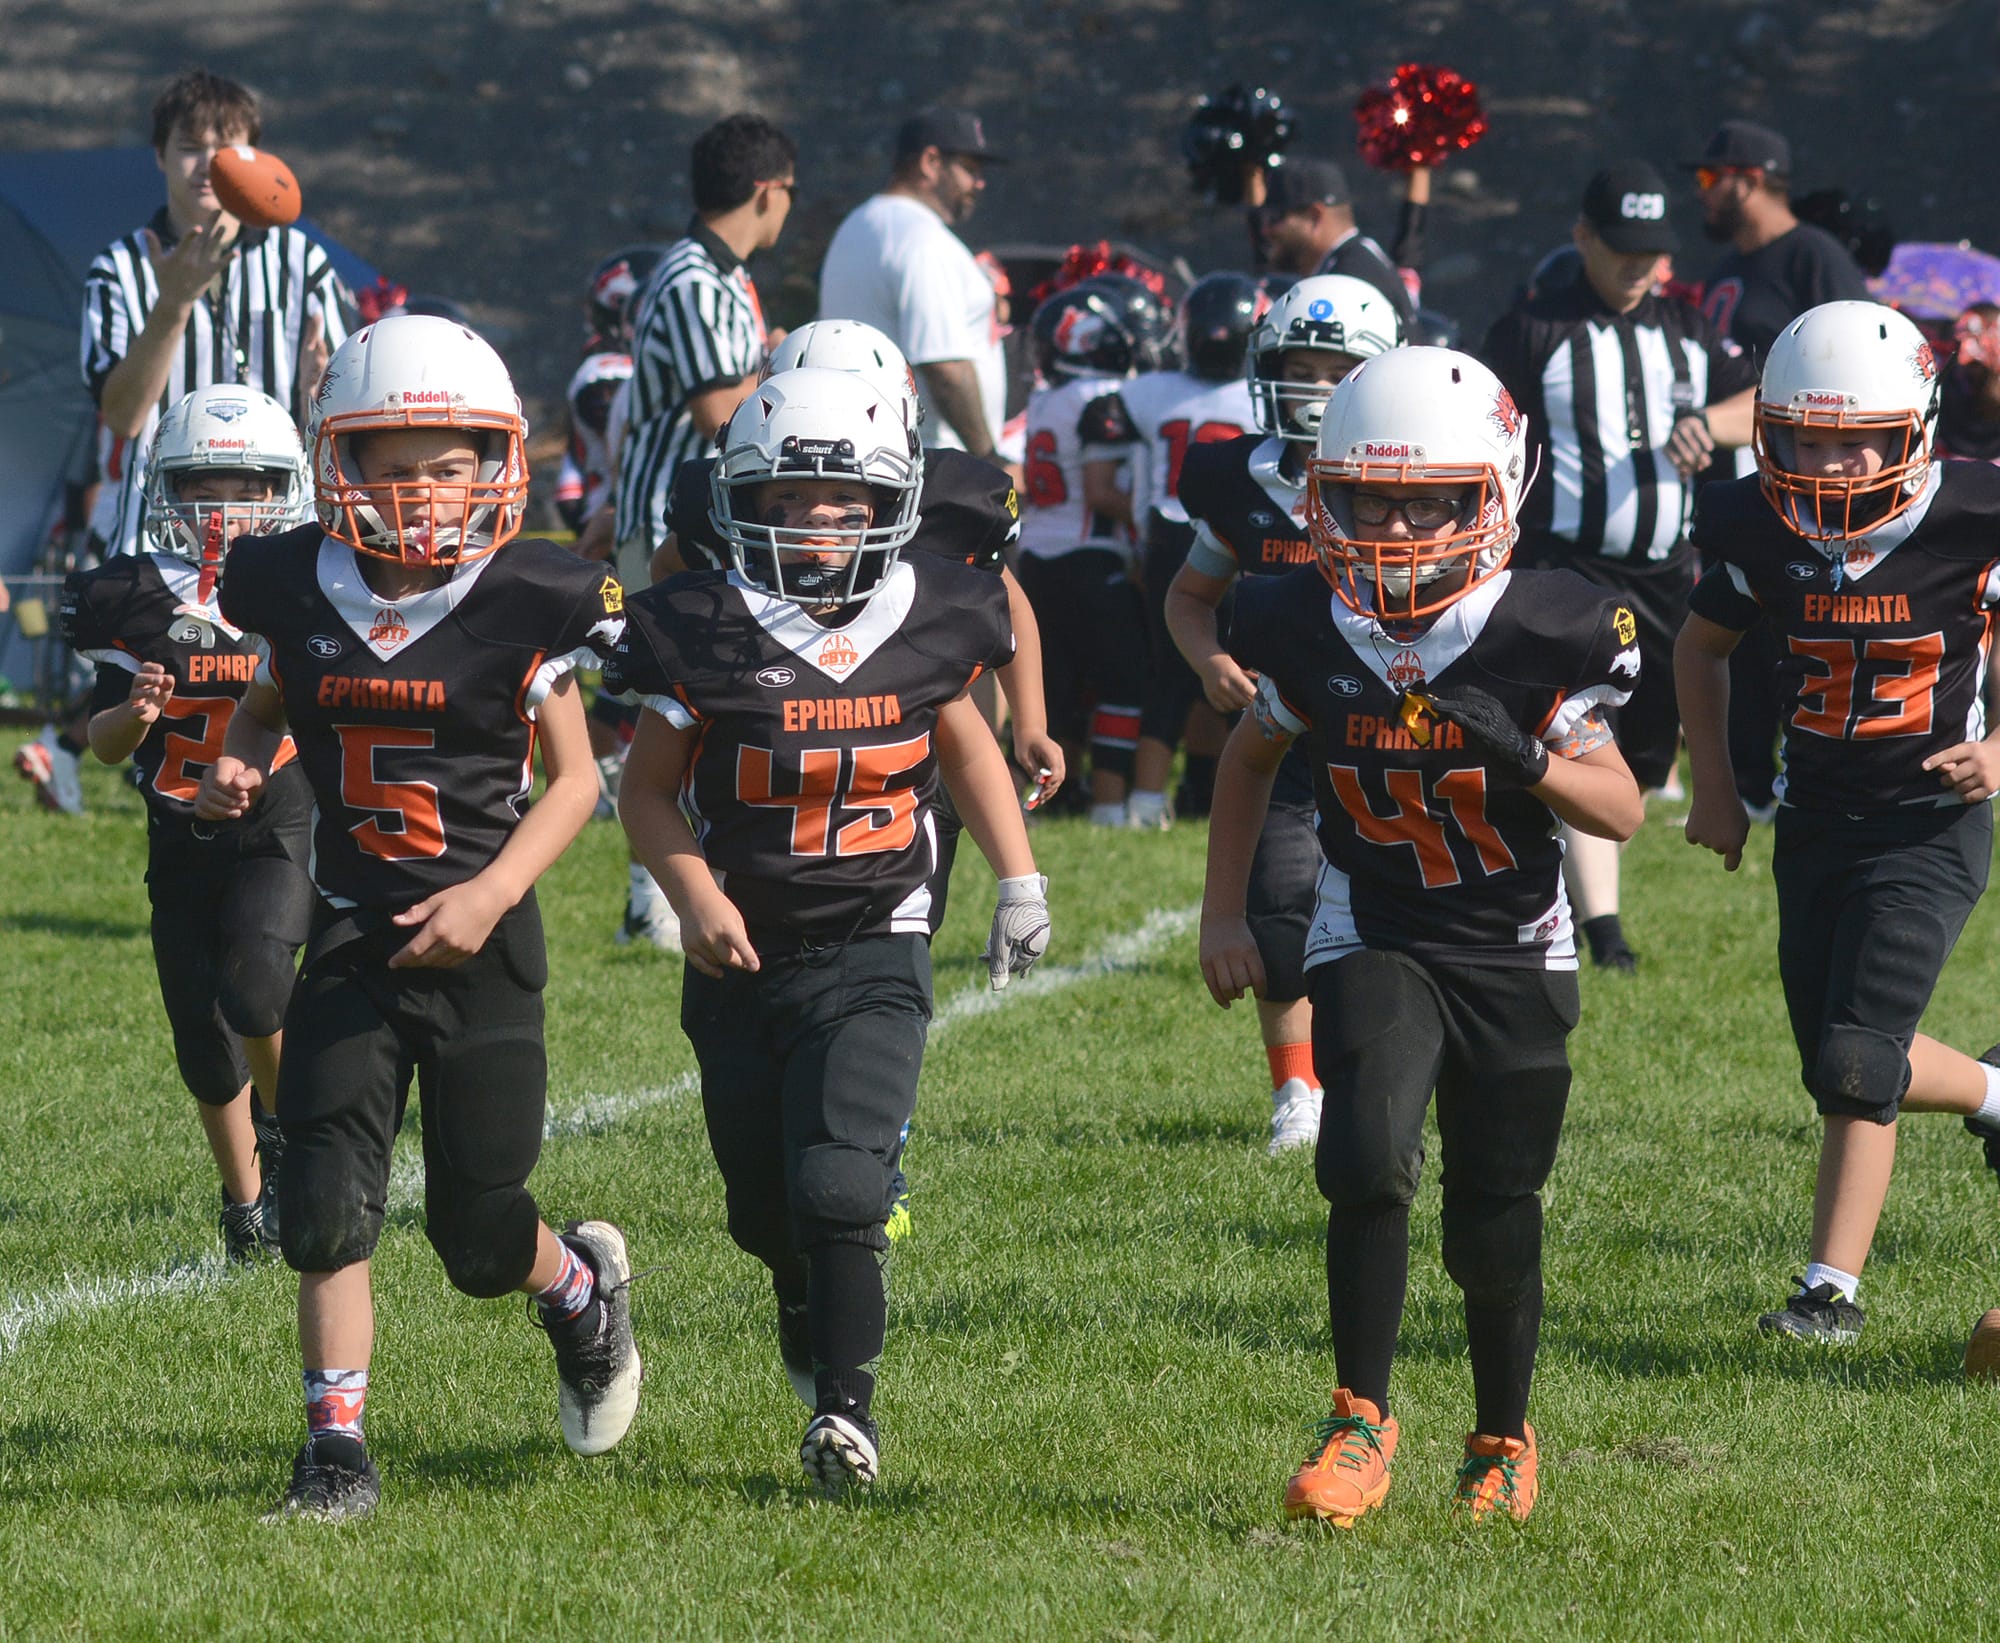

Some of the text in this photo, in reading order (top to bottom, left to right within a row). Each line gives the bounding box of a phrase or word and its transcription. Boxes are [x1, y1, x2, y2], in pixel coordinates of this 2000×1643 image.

[403, 391, 449, 404] Riddell
[1806, 393, 1844, 405] Riddell
[208, 438, 246, 449] Riddell
[801, 444, 834, 455] schutt
[1160, 419, 1246, 498] 1
[1365, 444, 1409, 457] Riddell
[1804, 593, 1912, 623] EPHRATA
[818, 649, 859, 667] CBYF
[317, 675, 446, 712] EPHRATA
[1787, 631, 1945, 740] 33
[783, 695, 902, 731] EPHRATA
[331, 724, 447, 861] 5
[736, 730, 930, 856] 45
[1327, 763, 1519, 889] 41
